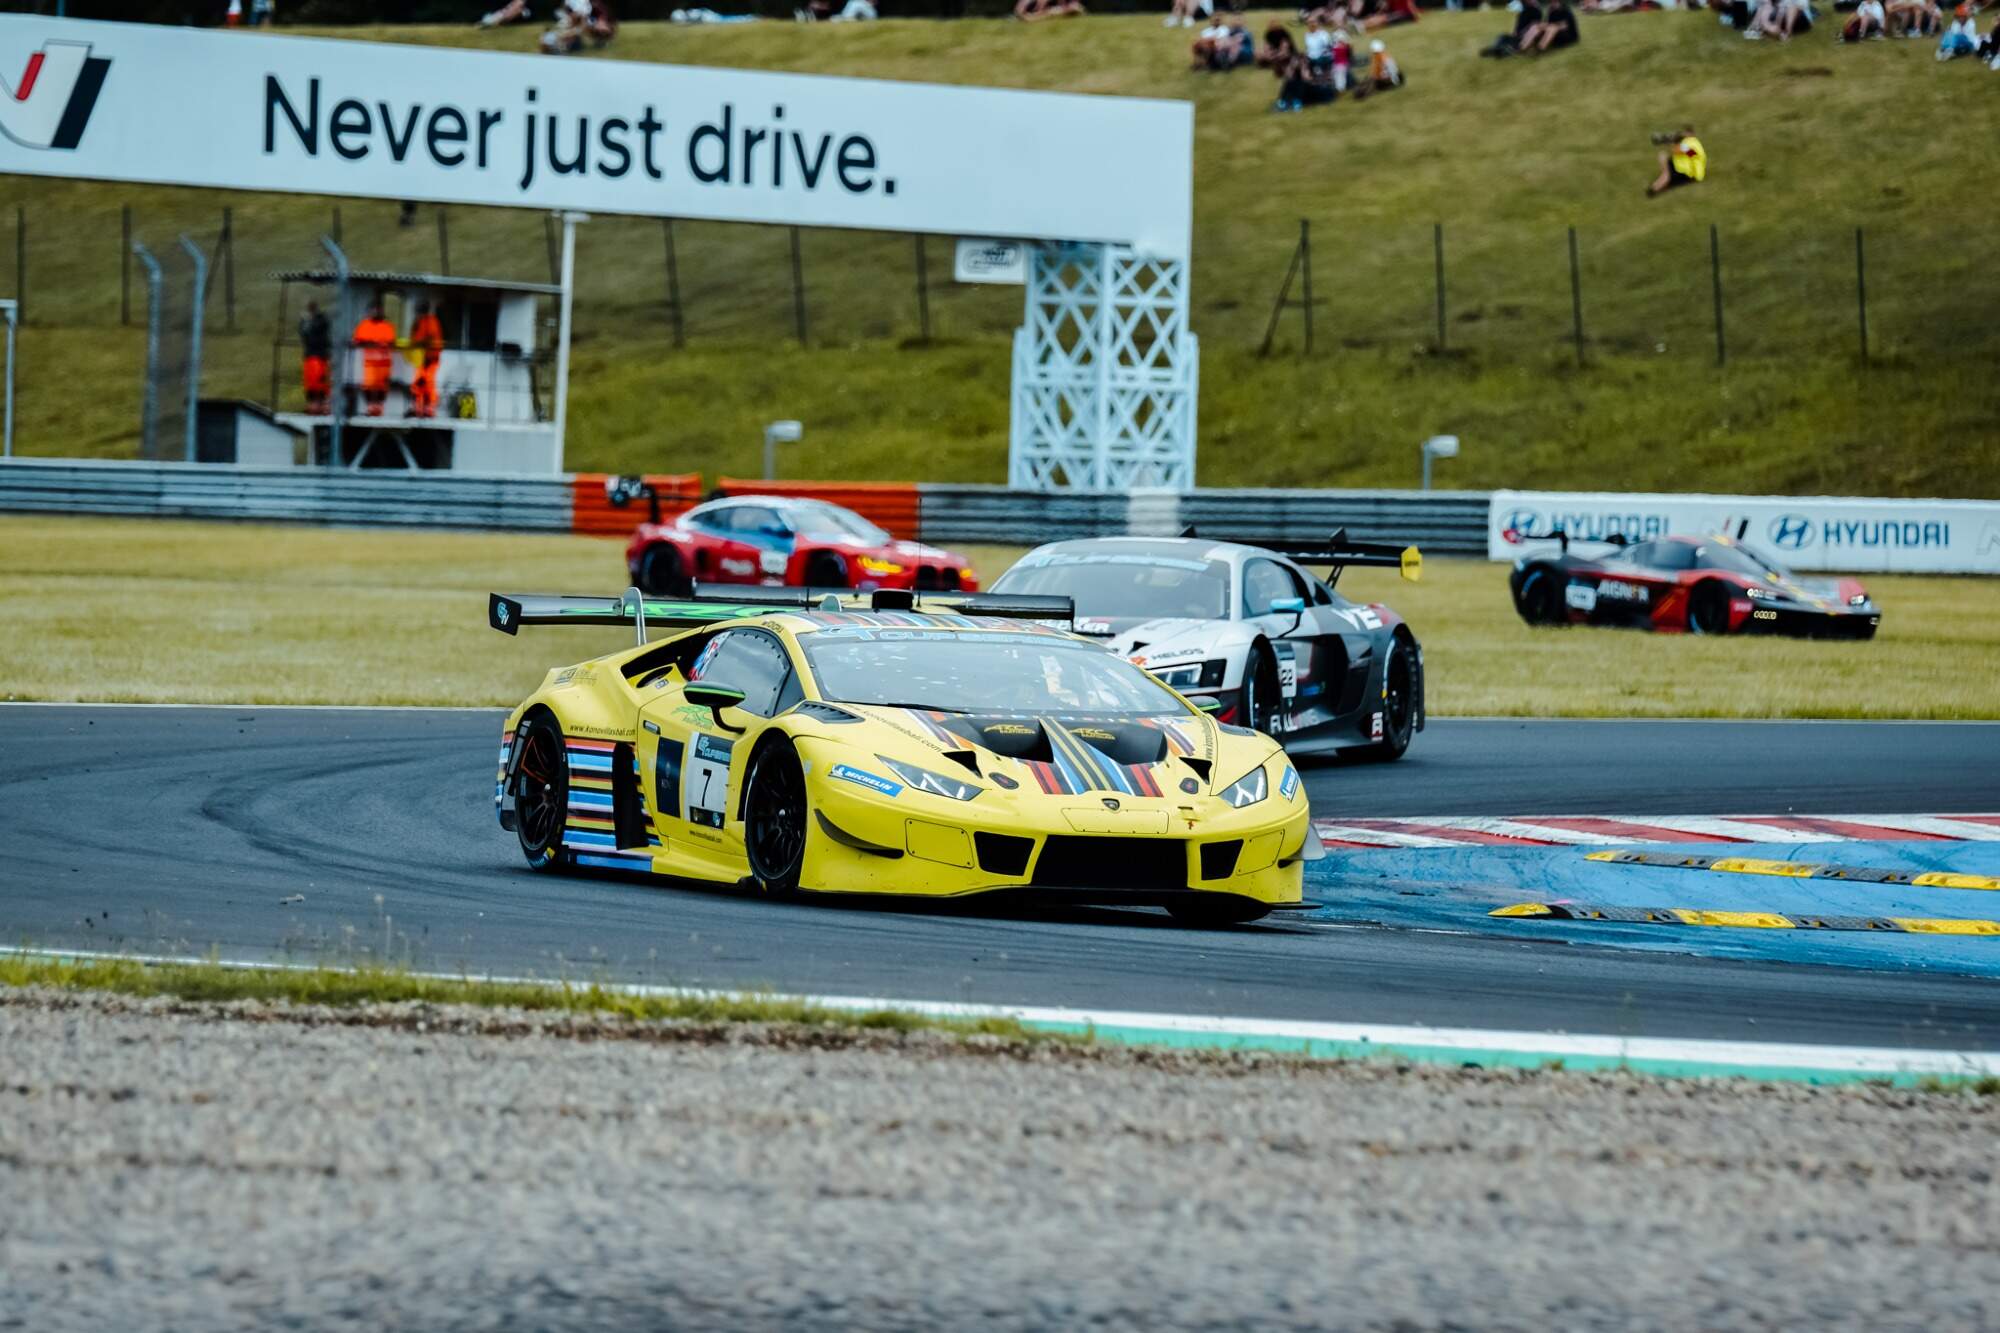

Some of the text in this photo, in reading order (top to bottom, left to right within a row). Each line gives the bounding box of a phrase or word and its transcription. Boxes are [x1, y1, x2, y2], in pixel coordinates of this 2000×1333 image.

[264, 74, 897, 195] Never just drive.
[1551, 513, 1669, 539] HYUNDAI
[1824, 520, 1949, 546] HYUNDAI
[1151, 648, 1204, 660] HELIOS
[702, 768, 713, 808] 7
[845, 770, 894, 791] MICHELIN
